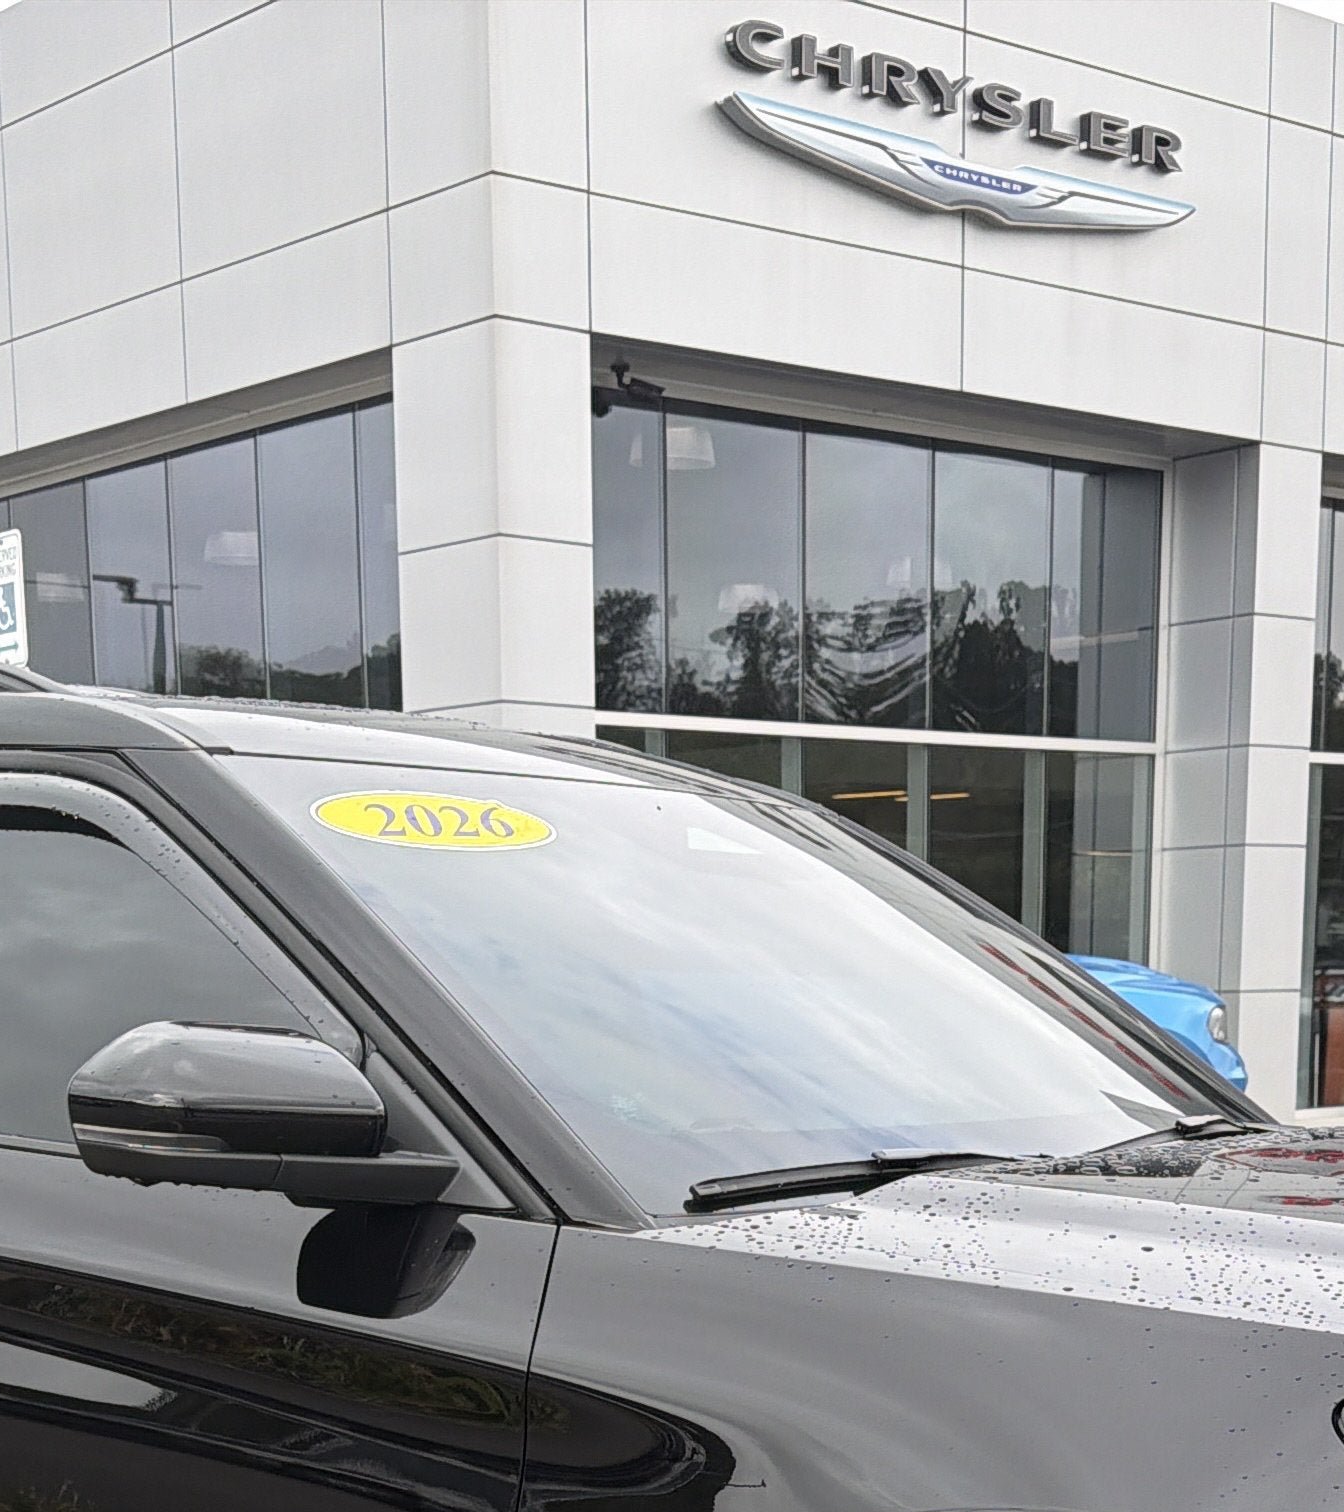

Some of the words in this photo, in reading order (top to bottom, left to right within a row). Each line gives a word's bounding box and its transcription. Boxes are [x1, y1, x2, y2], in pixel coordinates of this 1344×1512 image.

[725, 19, 1183, 173] CHRYSLER
[933, 164, 1022, 193] CHRYSLER
[363, 803, 515, 838] 2026
